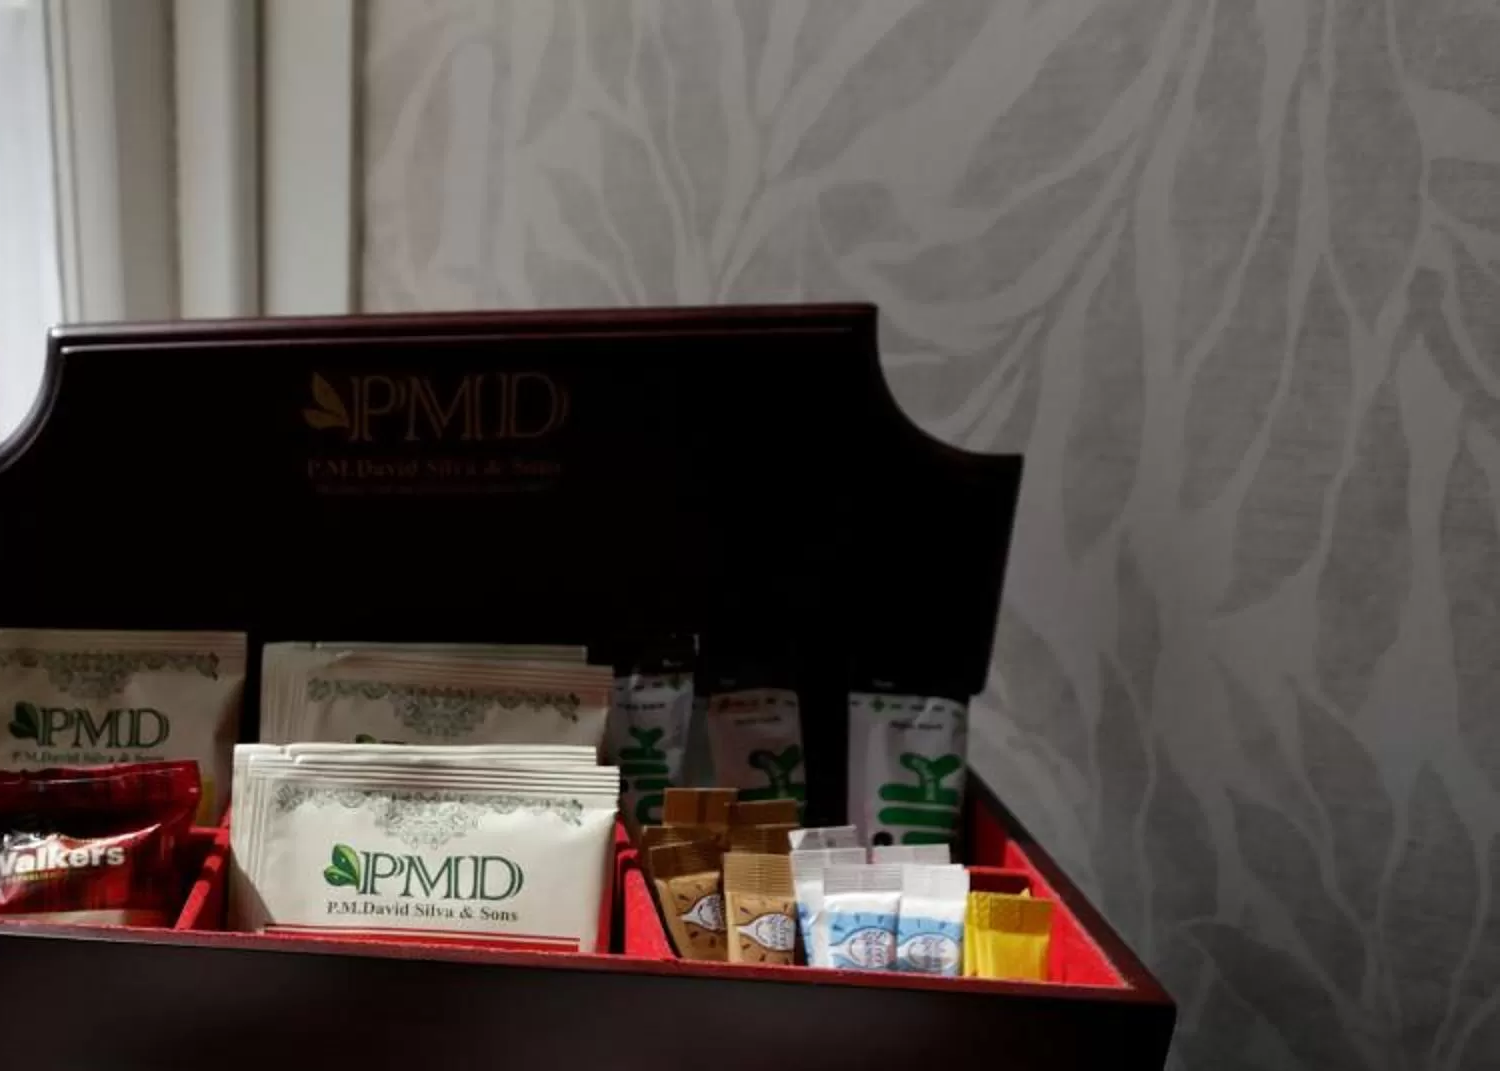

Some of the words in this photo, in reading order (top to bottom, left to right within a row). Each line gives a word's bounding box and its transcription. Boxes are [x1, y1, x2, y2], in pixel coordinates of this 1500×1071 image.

[347, 370, 571, 442] PMD
[37, 707, 170, 748] PMD
[358, 851, 524, 900] PMD
[327, 900, 410, 917] P.M.David
[414, 903, 455, 920] Silva
[459, 906, 474, 920] &
[480, 905, 519, 921] Sons
